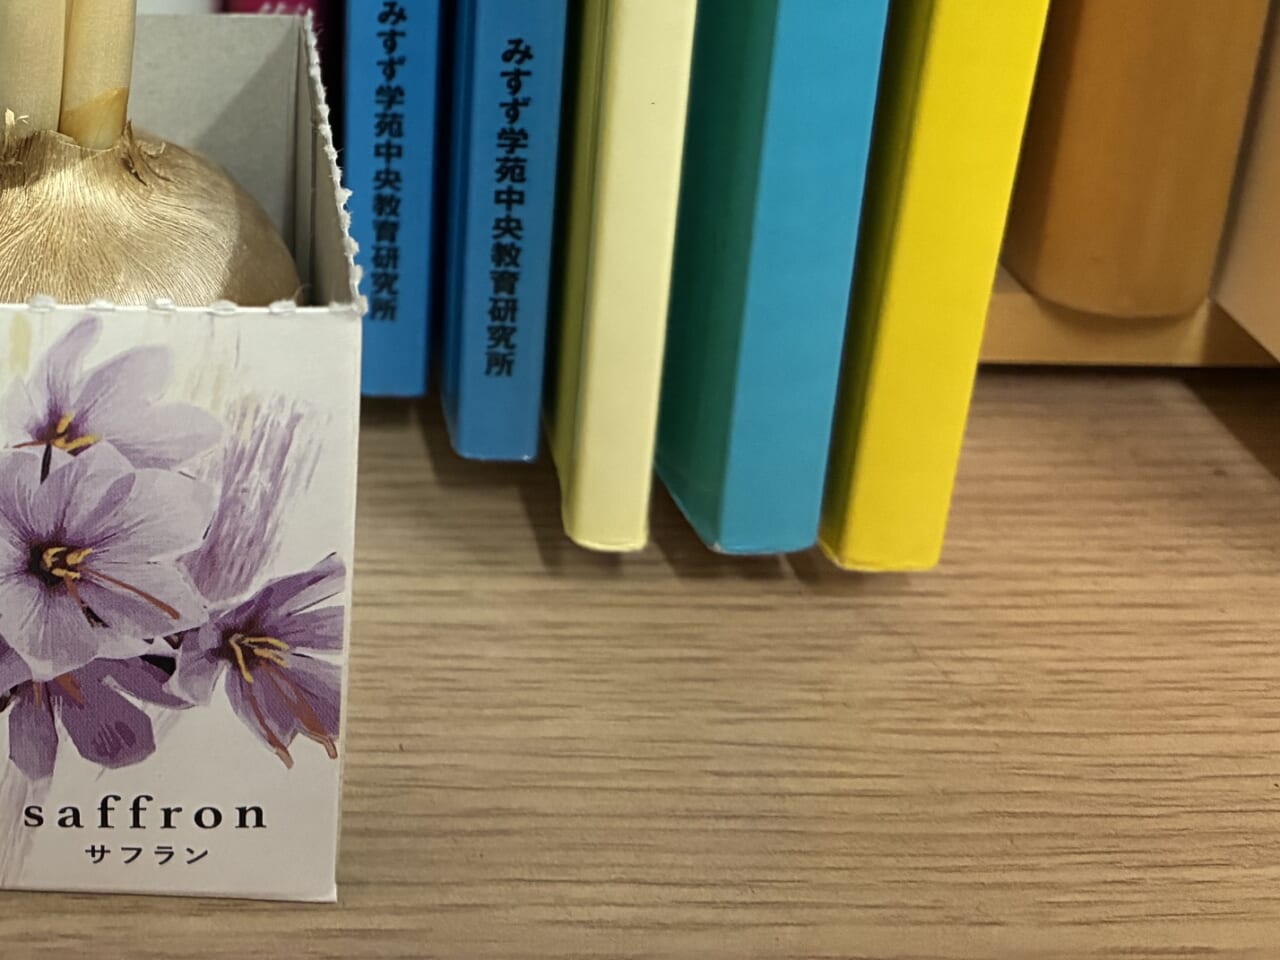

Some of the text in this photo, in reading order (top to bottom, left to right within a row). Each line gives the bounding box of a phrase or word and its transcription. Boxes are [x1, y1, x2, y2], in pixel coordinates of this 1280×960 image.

[369, 0, 407, 322] みすず学苑中央教育研究所
[485, 38, 534, 377] みすず学苑中央教育研究所
[23, 794, 267, 829] saffron
[85, 844, 209, 865] サフラン
